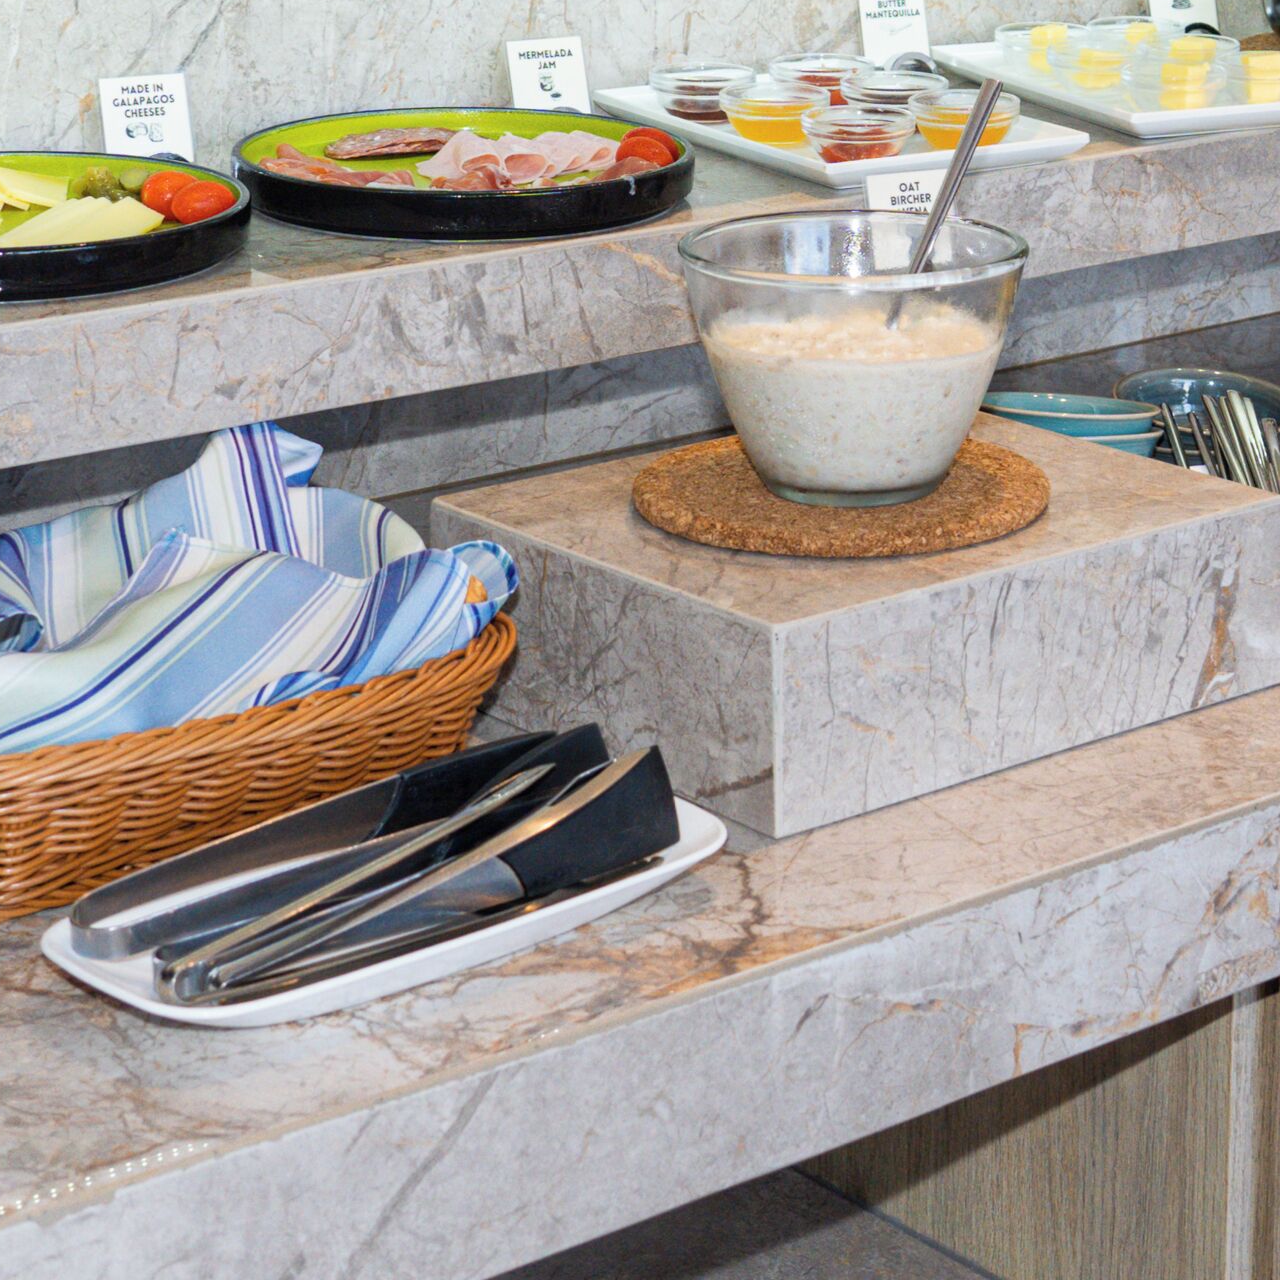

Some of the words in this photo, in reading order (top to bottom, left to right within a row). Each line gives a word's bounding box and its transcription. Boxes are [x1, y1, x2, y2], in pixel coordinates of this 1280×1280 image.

[877, 0, 905, 8] BUTTER
[866, 9, 920, 19] MANTEQUILLA
[518, 48, 573, 60] MERMELADA
[538, 61, 556, 70] JAM
[121, 84, 150, 94] MADE
[153, 83, 163, 92] IN
[112, 94, 175, 107] GALAPAGOS
[124, 107, 166, 118] CHEESES
[899, 181, 920, 192] OAT
[890, 193, 931, 206] BIRCHER
